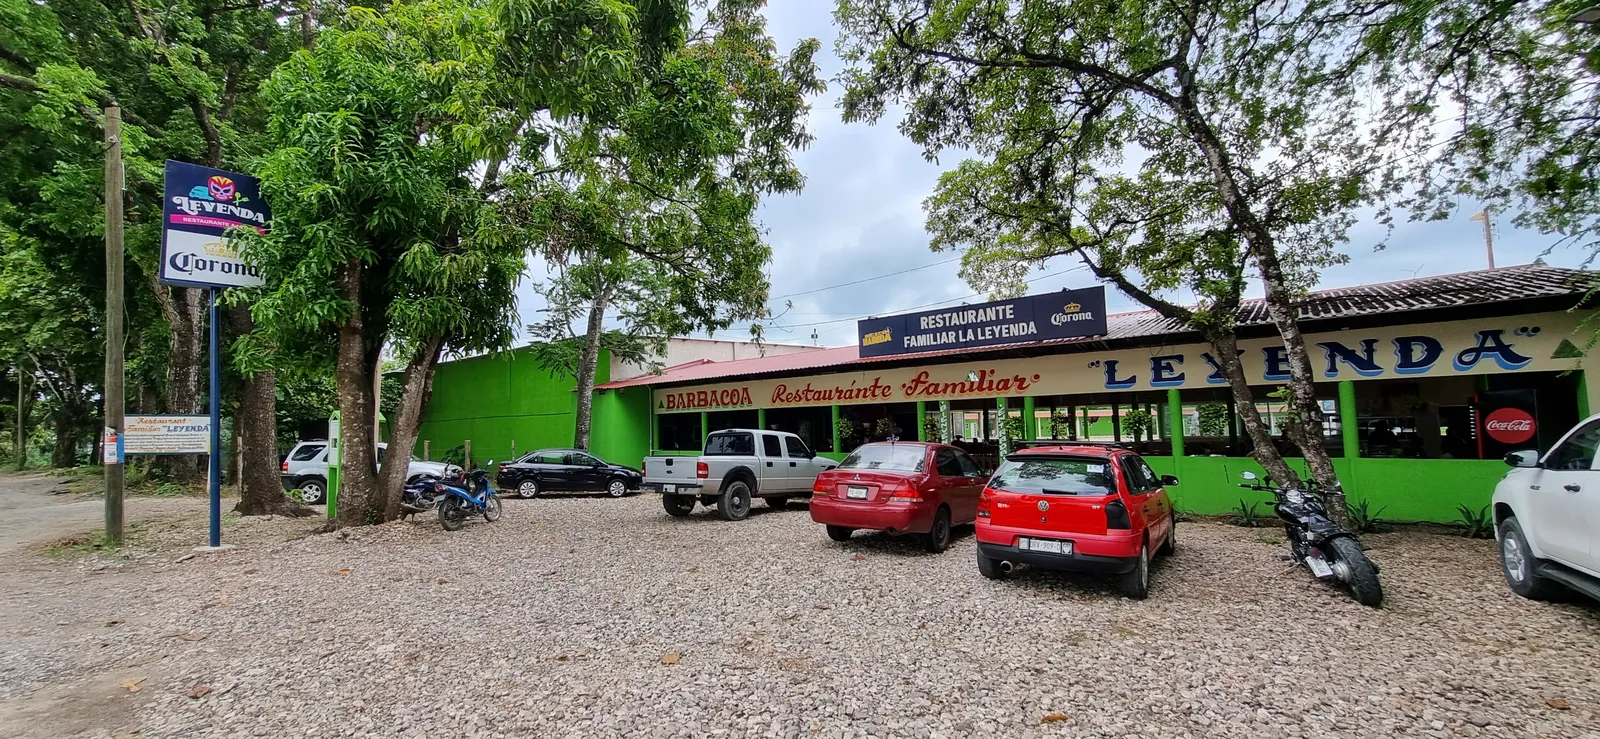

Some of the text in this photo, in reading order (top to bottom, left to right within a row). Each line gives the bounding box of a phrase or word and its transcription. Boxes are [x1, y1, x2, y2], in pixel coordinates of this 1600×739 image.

[172, 196, 265, 223] LEYENDA
[183, 217, 230, 227] RESTAURANTE
[169, 251, 260, 277] Corona
[920, 304, 1014, 329] RESTAURANTE
[1051, 311, 1092, 326] Corona
[903, 331, 956, 348] FAMILIAR
[958, 329, 974, 342] LA
[976, 321, 1037, 340] LEYENDA
[665, 387, 753, 411] BARBACOA
[1486, 420, 1532, 431] Coca-Cola
